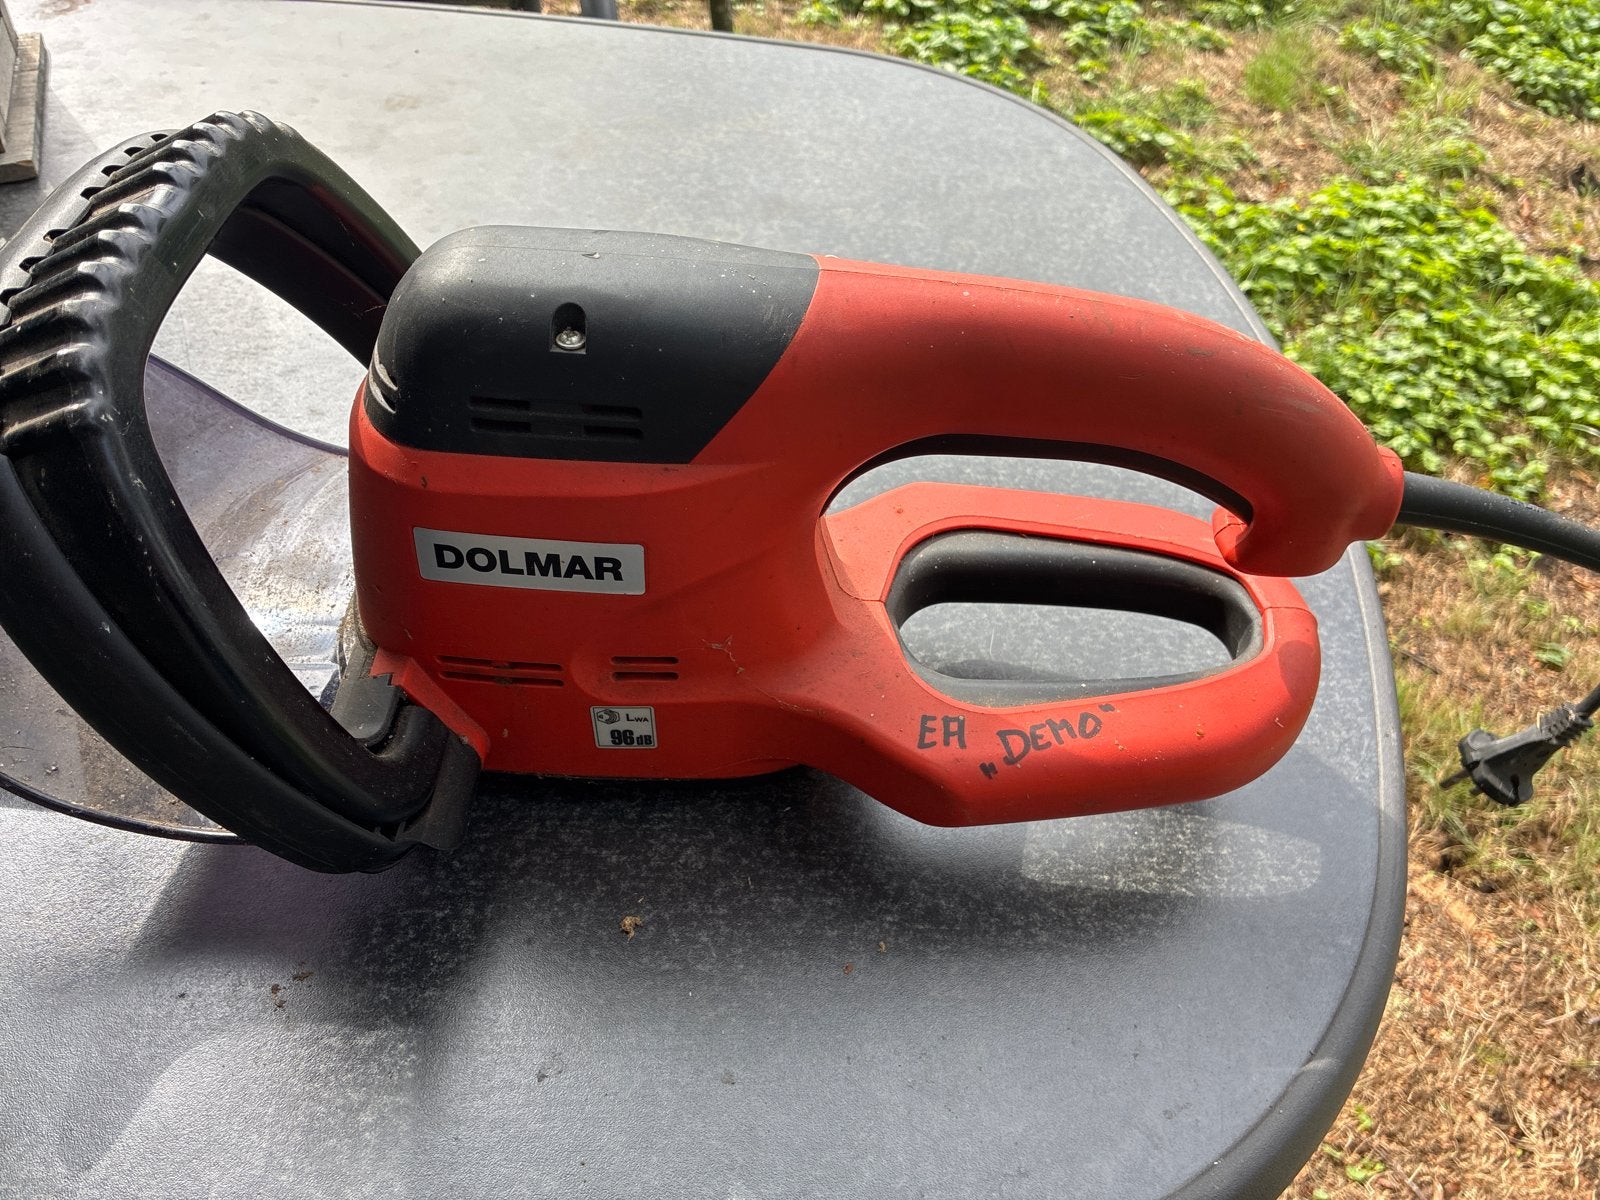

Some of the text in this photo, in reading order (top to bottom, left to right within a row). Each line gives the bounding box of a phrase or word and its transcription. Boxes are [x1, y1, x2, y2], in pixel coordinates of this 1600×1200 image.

[433, 543, 624, 581] DOLMAR
[610, 729, 653, 746] 96 dB
[917, 714, 967, 750] EA
